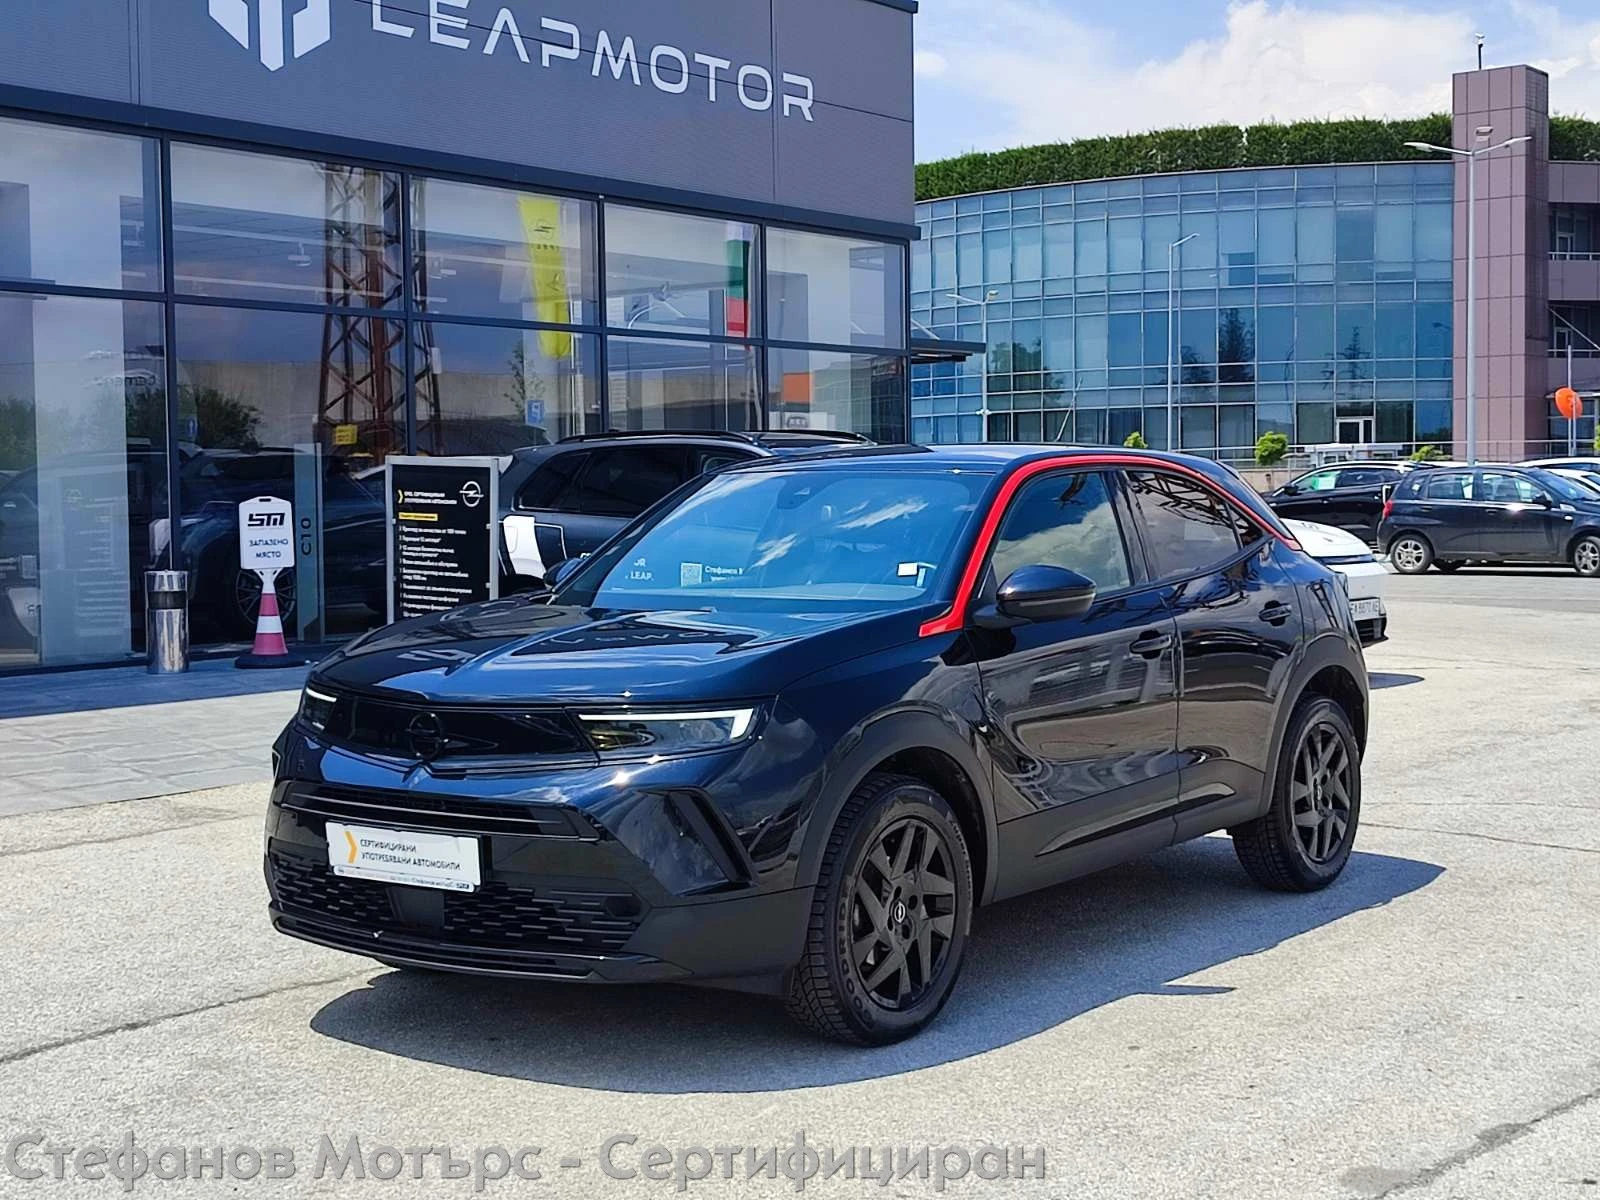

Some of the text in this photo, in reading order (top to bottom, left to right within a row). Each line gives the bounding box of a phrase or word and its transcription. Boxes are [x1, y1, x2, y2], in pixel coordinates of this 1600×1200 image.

[371, 0, 815, 122] LEAPMOTOR
[249, 538, 289, 547] ЗАПАЗЕНО
[300, 517, 312, 556] C10
[255, 550, 282, 559] МЯСТО
[359, 838, 417, 853] СЕРТИФИЦИРАНИ
[361, 851, 461, 871] УПОТРЕБЯВАНИ АВТОМОБИЛИ
